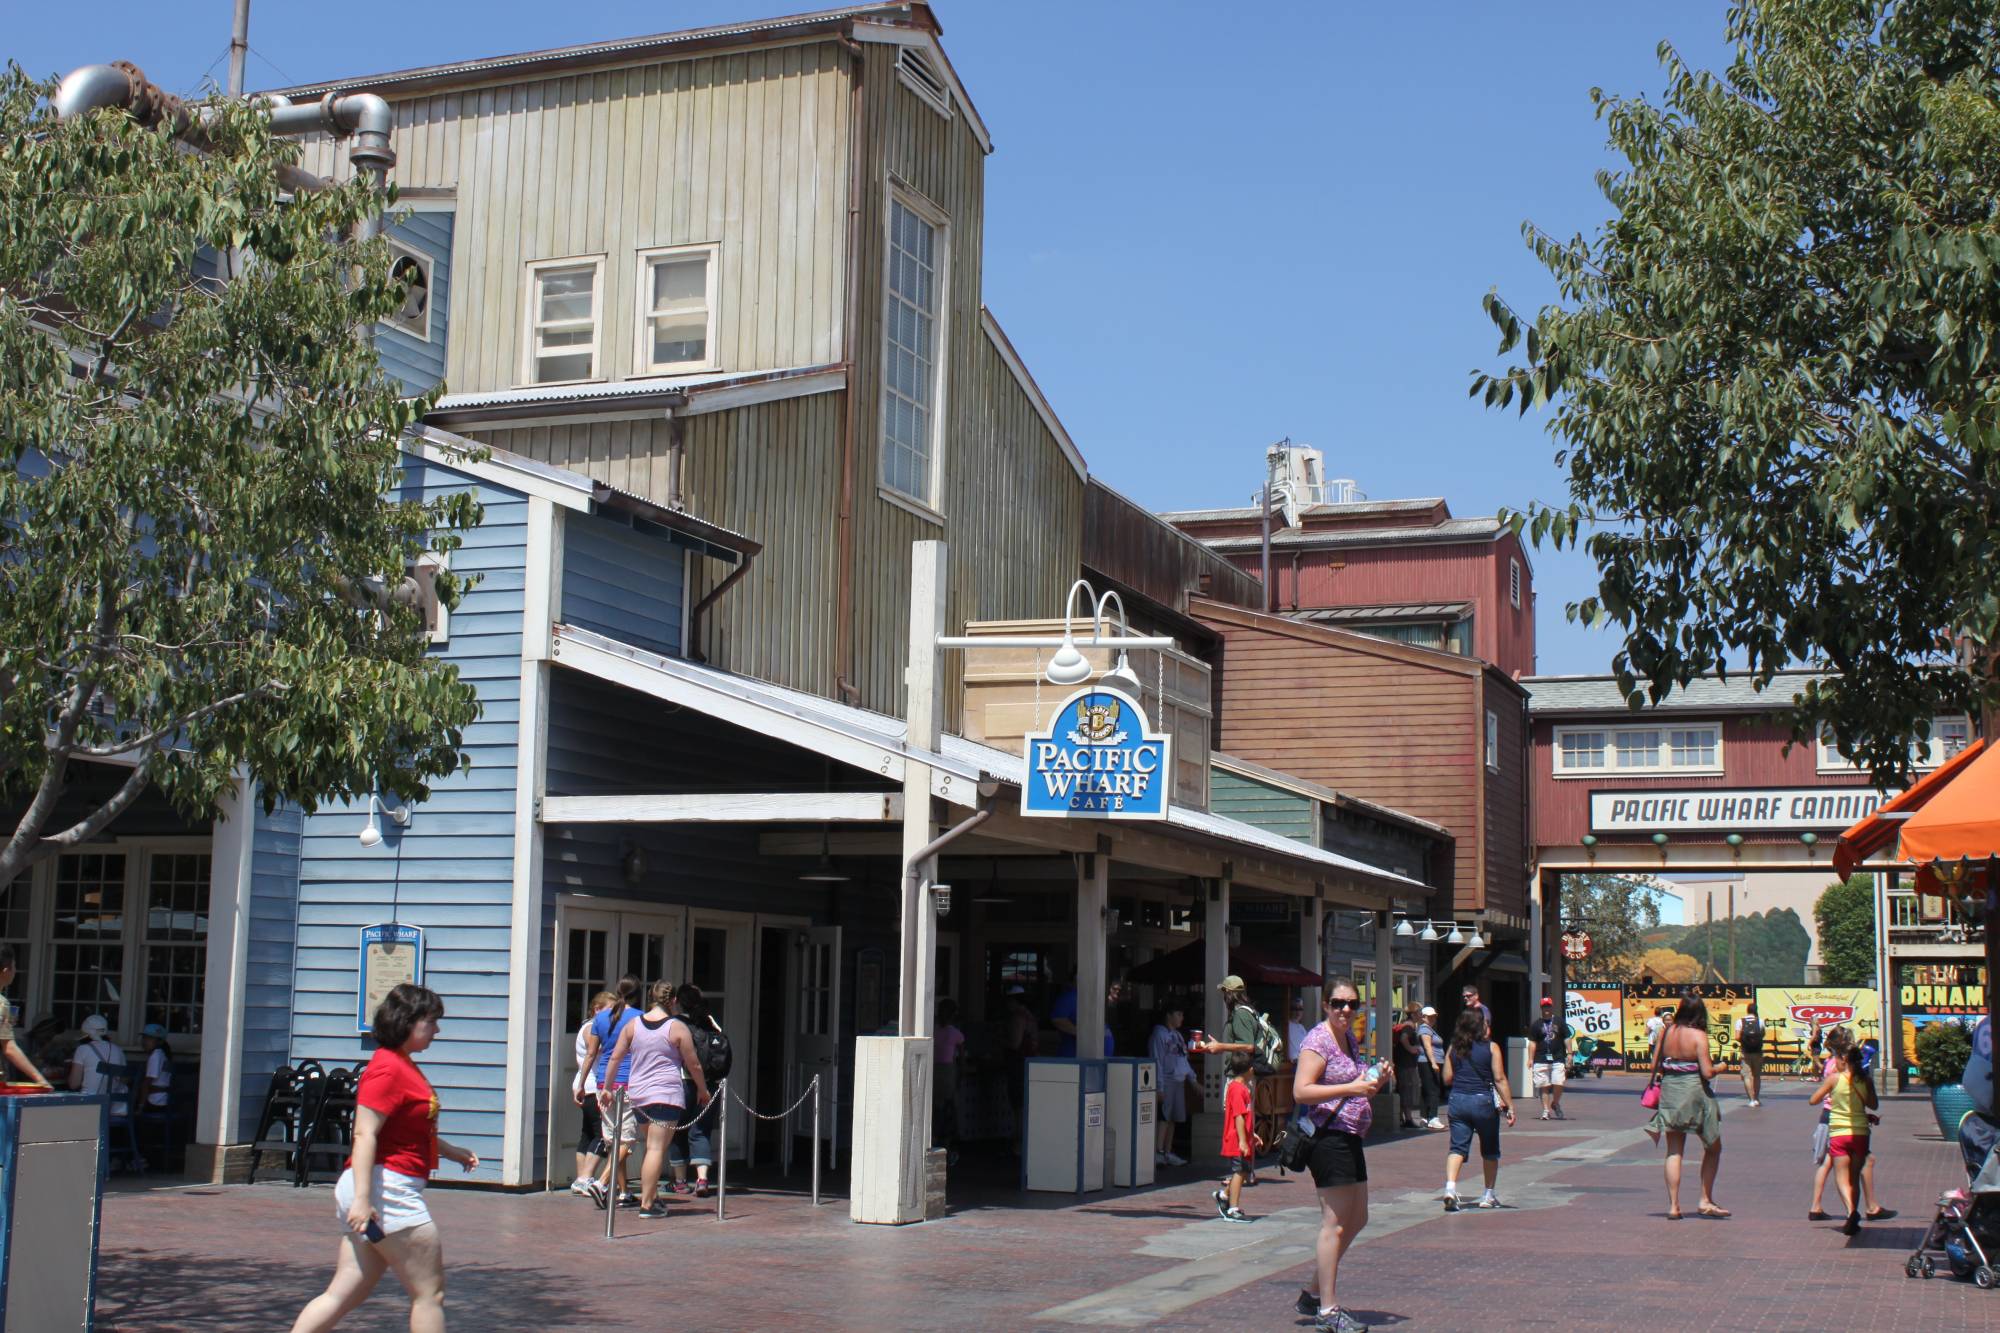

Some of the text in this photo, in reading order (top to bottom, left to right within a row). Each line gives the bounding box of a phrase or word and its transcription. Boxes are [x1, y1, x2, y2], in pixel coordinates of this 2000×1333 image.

[1036, 743, 1157, 774] PACIFIC
[1043, 772, 1149, 799] WHARF
[1069, 796, 1124, 809] CAFÉ
[1610, 798, 1690, 822] PACIFIC
[1697, 797, 1782, 822] WHARF
[366, 930, 418, 938] PACIFIC WHARF
[1795, 1007, 1848, 1020] Cars
